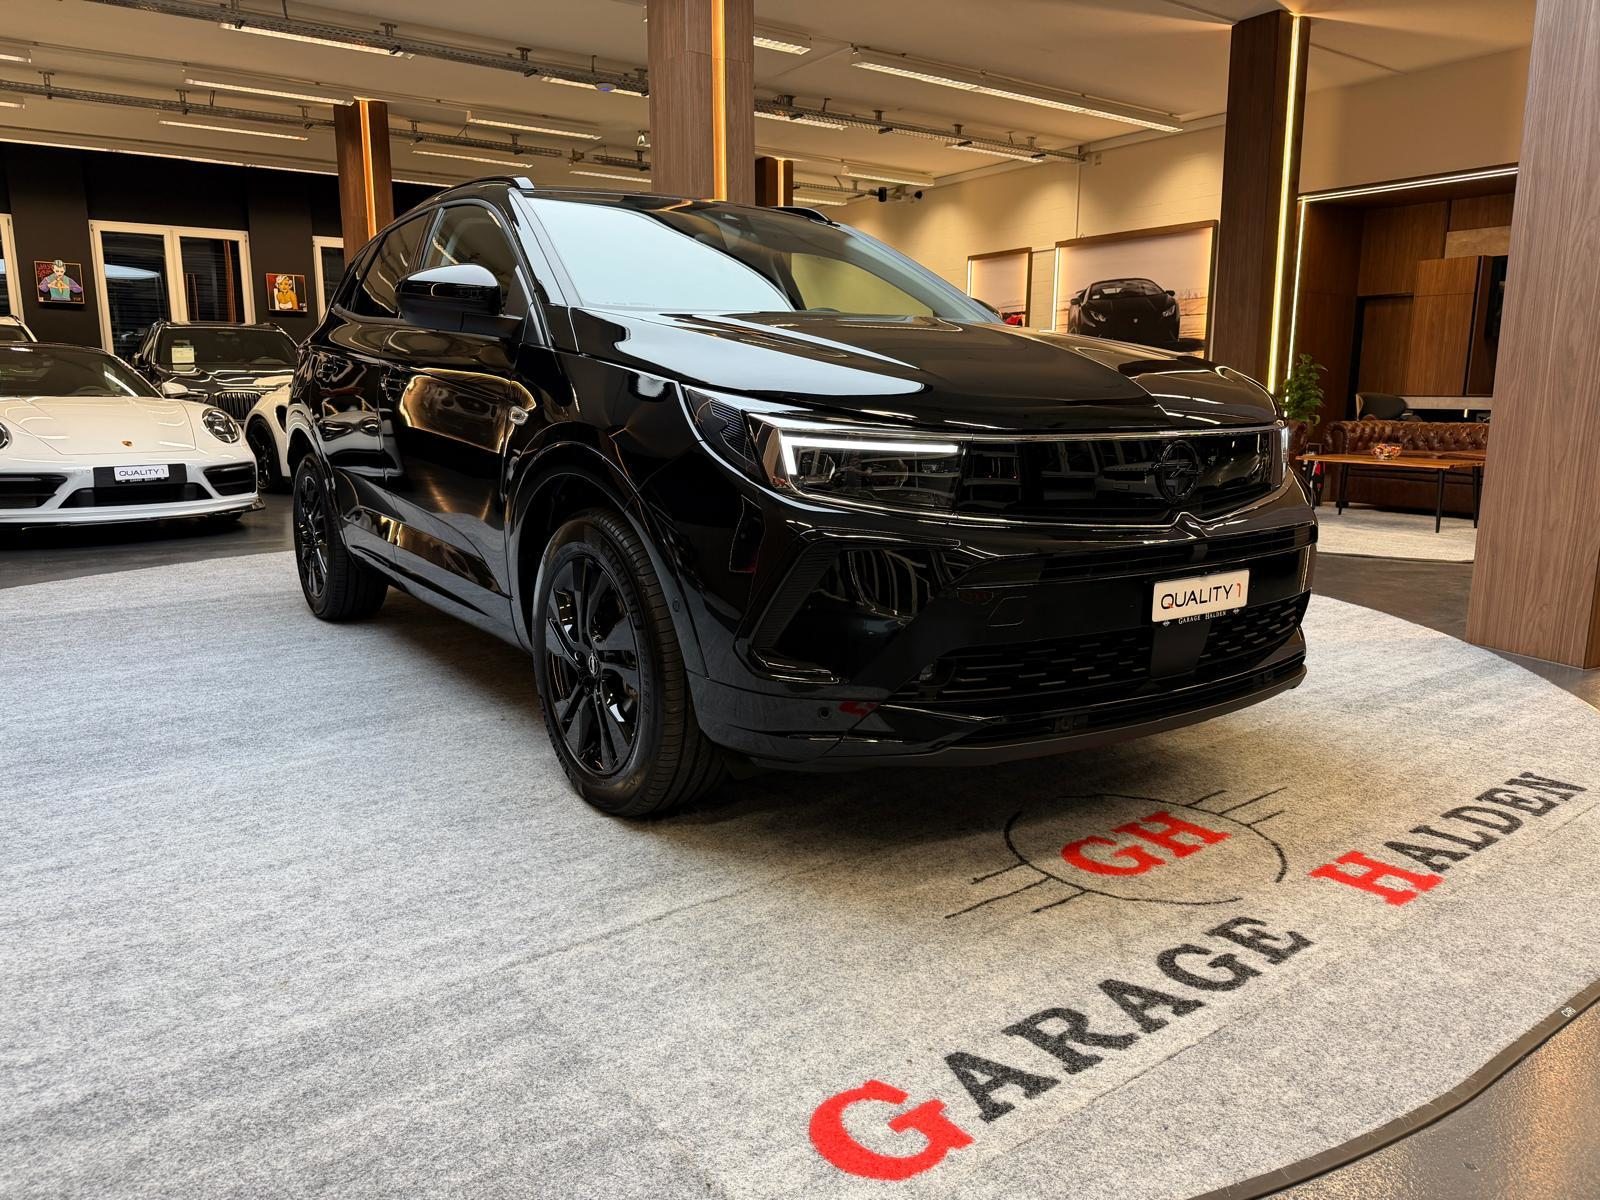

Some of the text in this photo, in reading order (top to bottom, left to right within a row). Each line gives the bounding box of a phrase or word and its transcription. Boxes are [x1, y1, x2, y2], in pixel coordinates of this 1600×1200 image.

[118, 468, 159, 477] QUALITY
[1161, 583, 1242, 609] QUALITY 1
[1061, 811, 1232, 876] GH
[809, 772, 1588, 1181] GARAGE HALDEN
